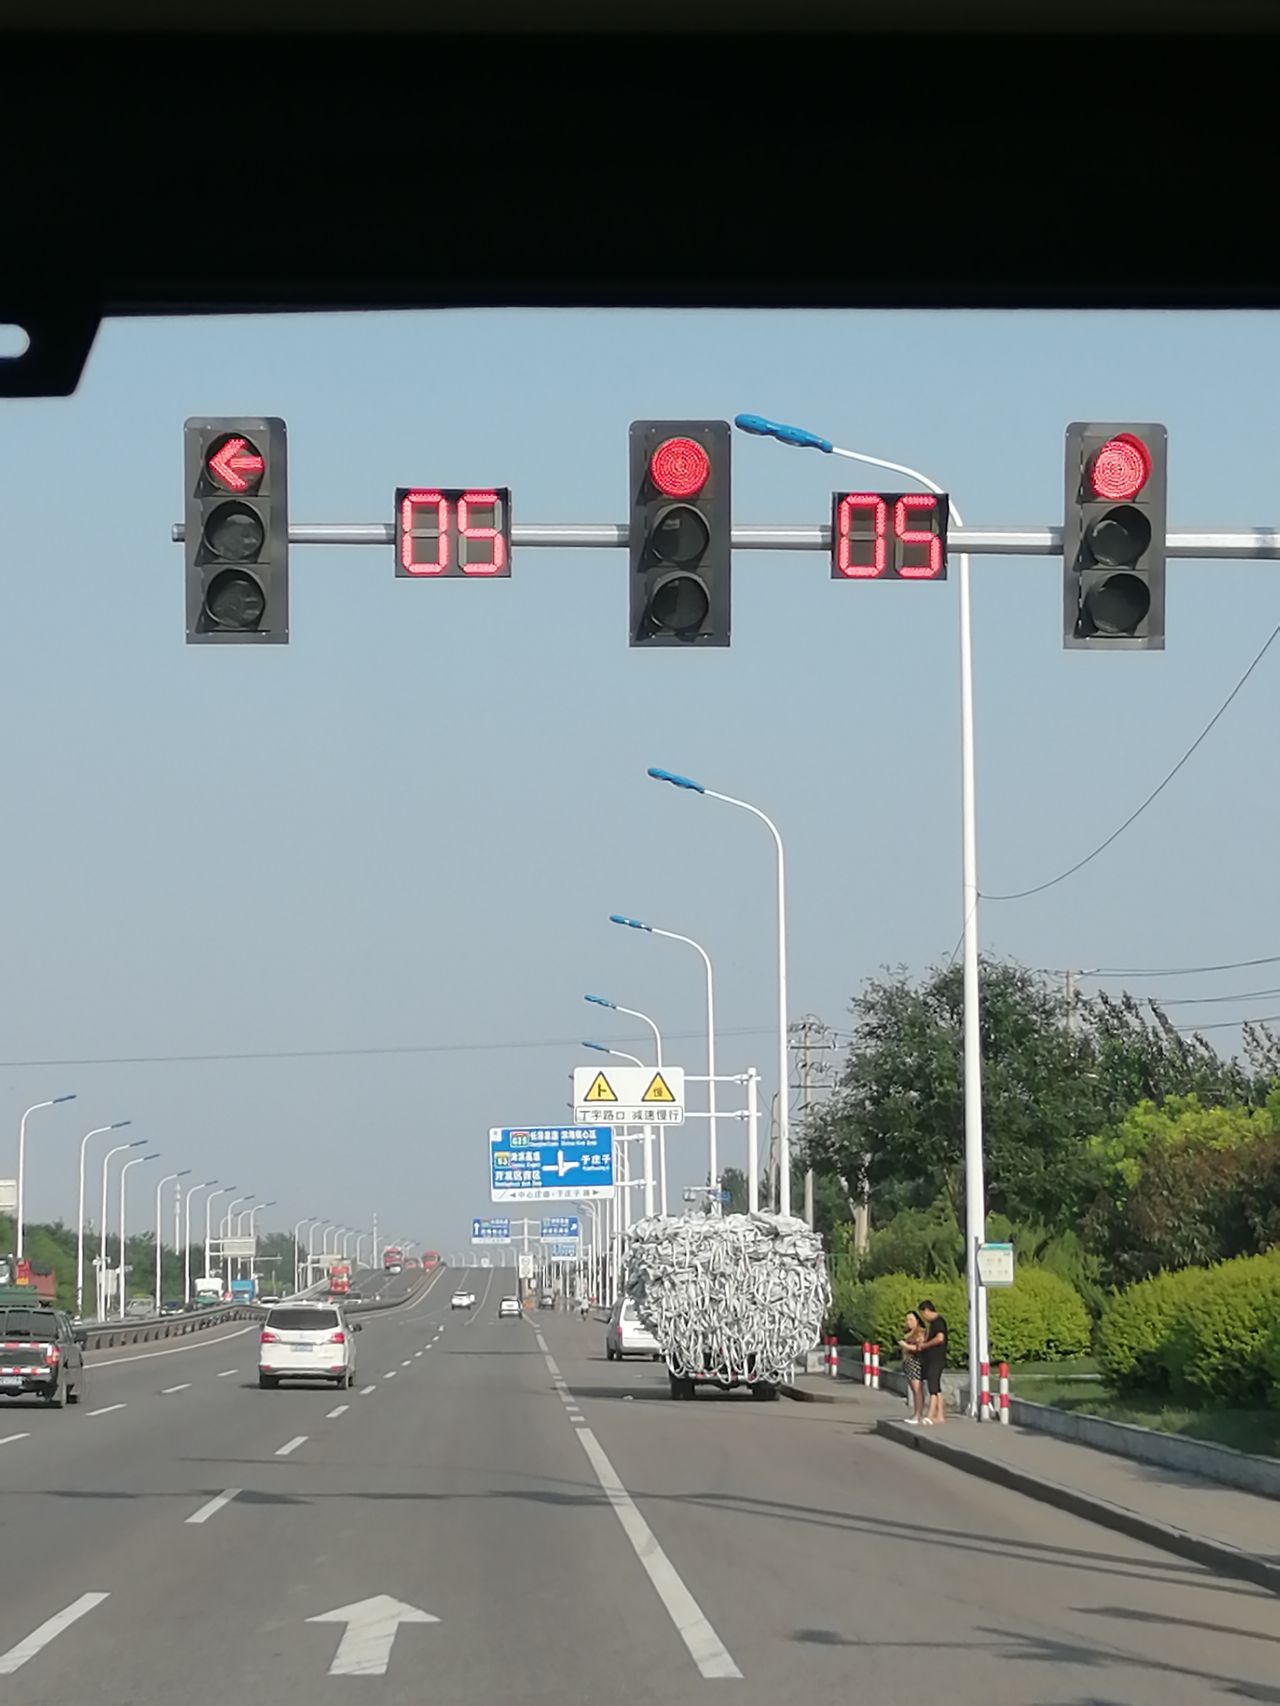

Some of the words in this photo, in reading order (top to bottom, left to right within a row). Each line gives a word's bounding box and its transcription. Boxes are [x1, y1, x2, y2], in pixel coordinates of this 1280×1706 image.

[401, 493, 504, 575] 05
[838, 495, 942, 578] 05
[579, 1110, 625, 1121] 丁字路口
[632, 1109, 679, 1121] 减速慢行
[653, 1087, 663, 1097] 慢
